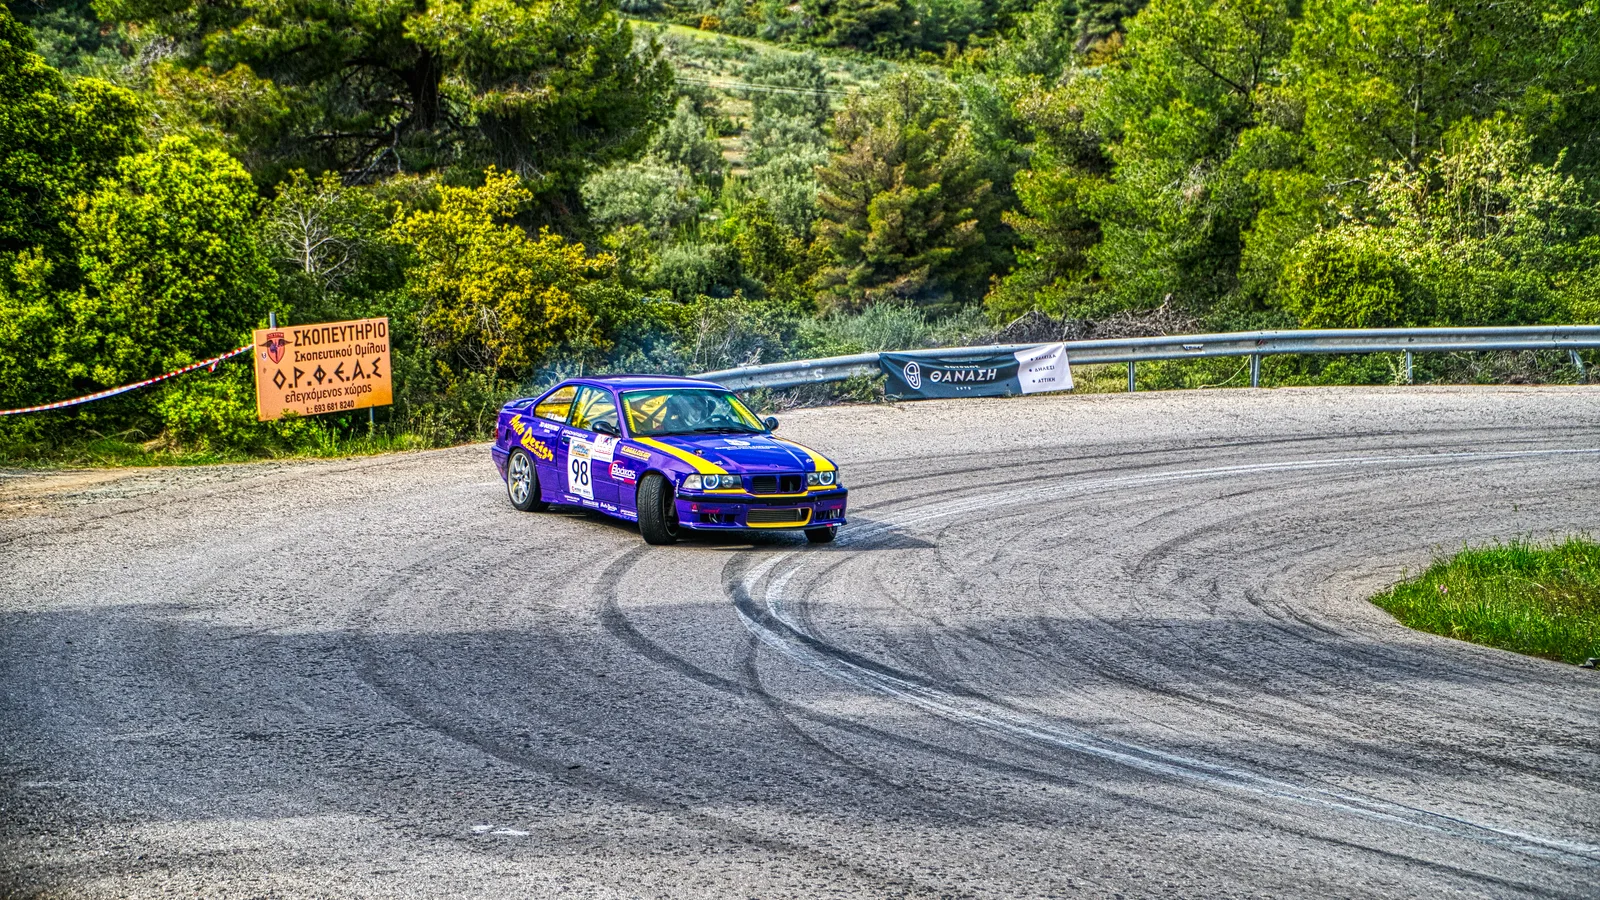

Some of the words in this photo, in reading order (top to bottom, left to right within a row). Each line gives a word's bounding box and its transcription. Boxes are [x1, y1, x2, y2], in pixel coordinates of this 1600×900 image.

[293, 322, 386, 347] ΣΚΟΠΕΥΤΗΡΙΟ
[294, 344, 353, 362] Σκοπευτικού
[355, 342, 386, 358] Ομίλου
[930, 368, 997, 383] ΘΑΝΑΣΗ
[285, 388, 343, 404] ελεγχόμενος
[344, 384, 372, 397] χώρος
[314, 403, 326, 413] 693
[326, 401, 338, 412] 681
[340, 400, 355, 410] 8240
[572, 459, 589, 486] 98
